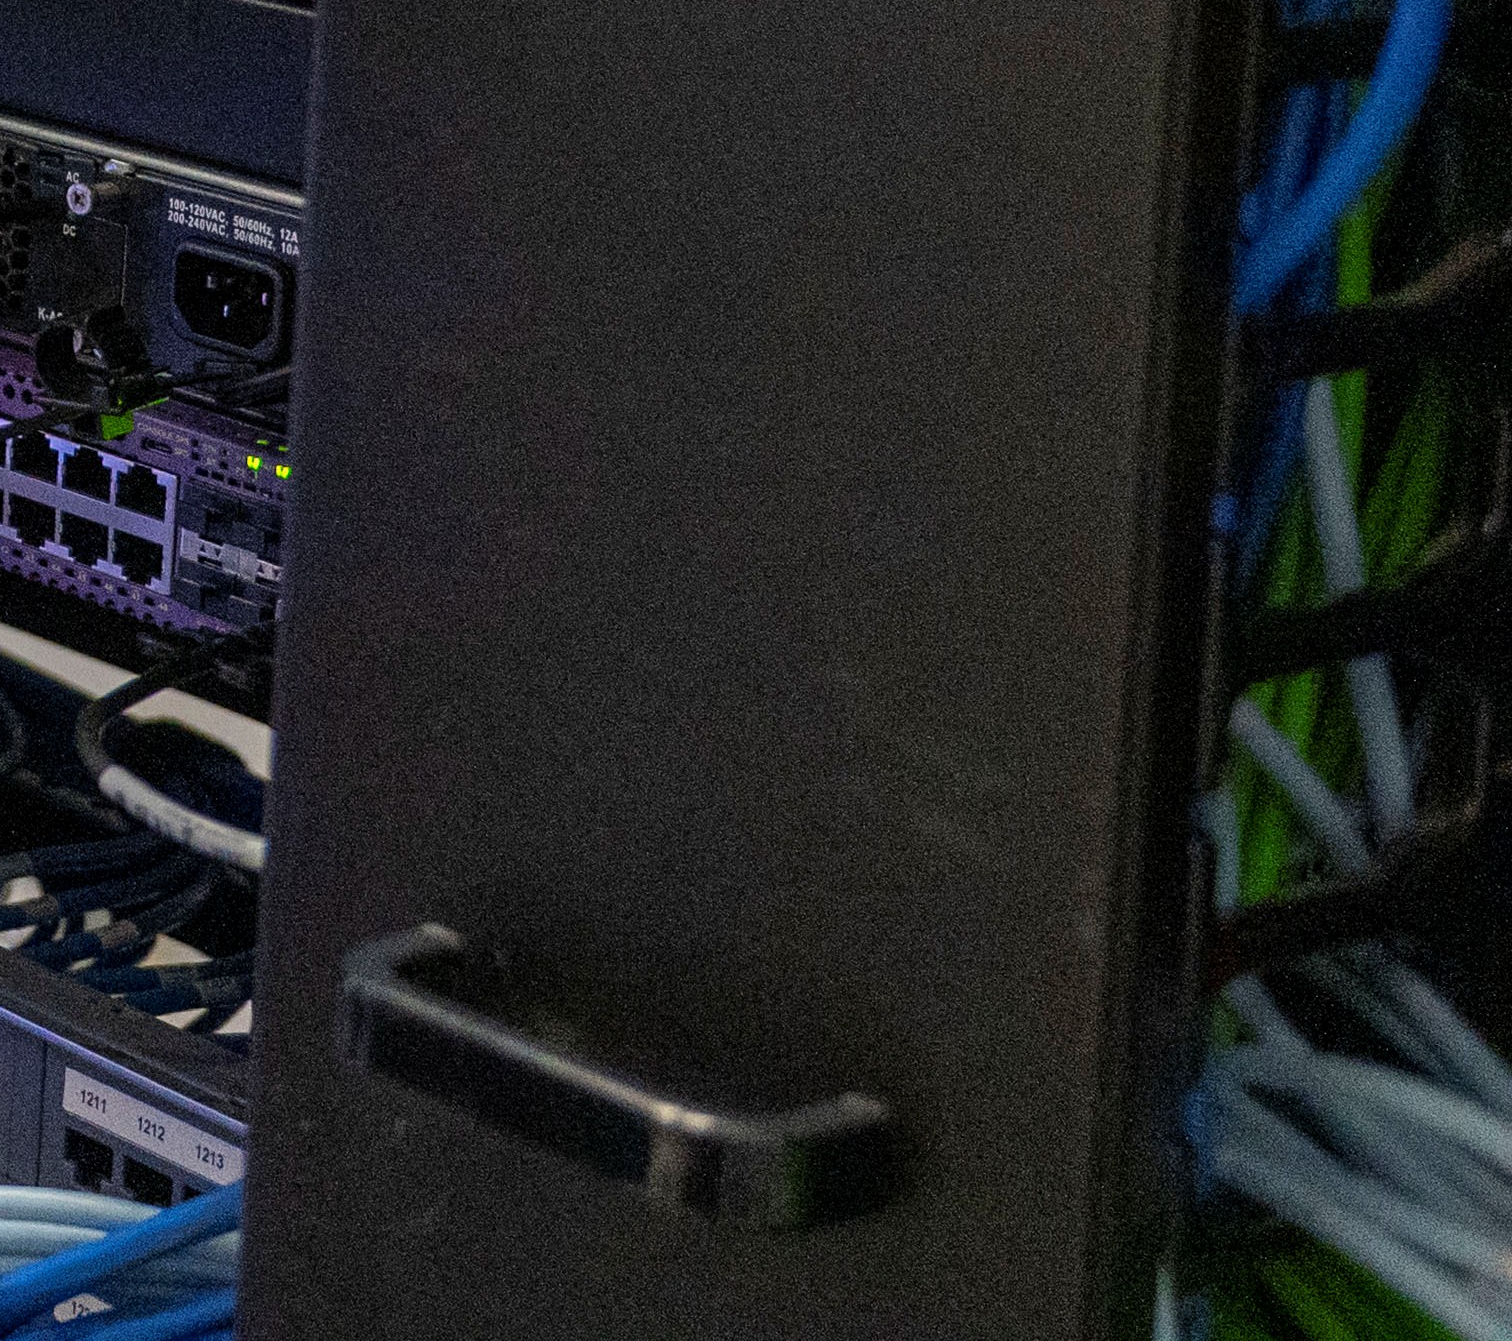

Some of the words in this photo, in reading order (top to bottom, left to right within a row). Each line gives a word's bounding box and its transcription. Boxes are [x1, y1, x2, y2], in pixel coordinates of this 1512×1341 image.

[66, 170, 80, 184] AC
[62, 223, 77, 237] DC
[167, 210, 229, 238] 200-240VAC,
[281, 242, 301, 257] 10A
[169, 197, 228, 225] 100-120VAC,
[279, 227, 299, 243] 12A
[79, 1089, 107, 1115] 1211
[137, 1116, 166, 1142] 1212
[195, 1143, 225, 1170] 1213
